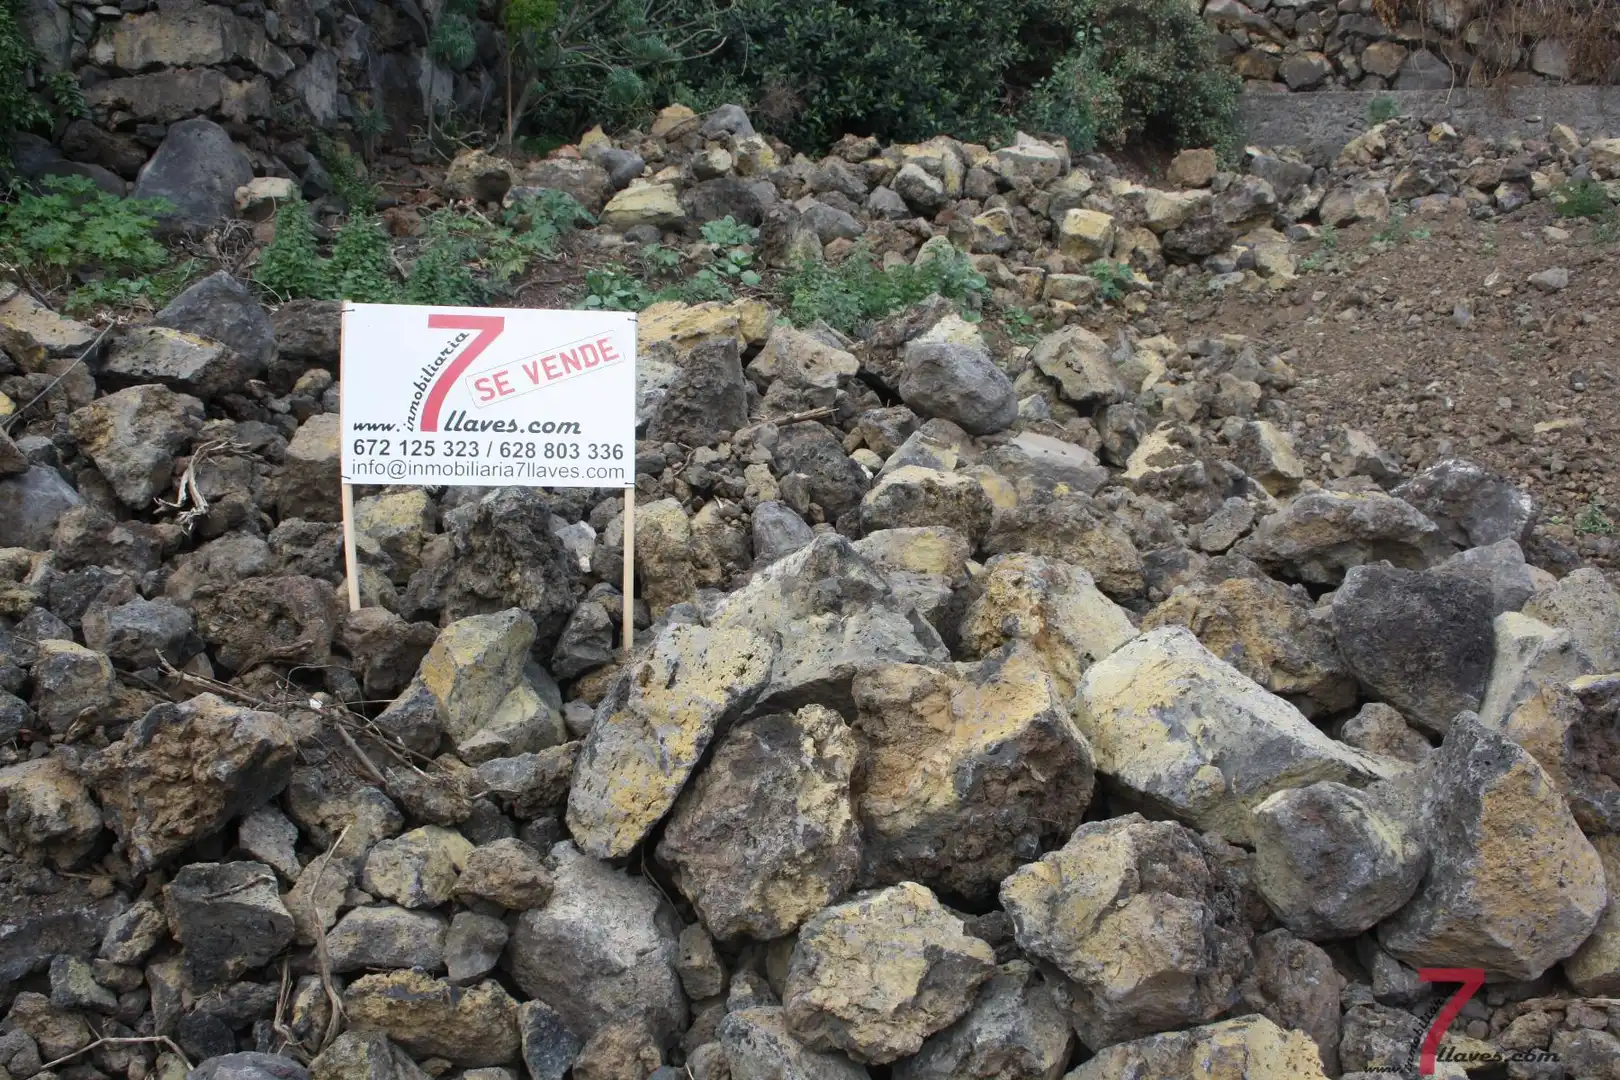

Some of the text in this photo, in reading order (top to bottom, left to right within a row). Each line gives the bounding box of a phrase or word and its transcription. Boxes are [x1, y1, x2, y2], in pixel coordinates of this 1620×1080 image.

[403, 332, 469, 432] inmobiliaria
[420, 314, 505, 432] 7
[474, 337, 620, 401] SE VENDE
[444, 410, 582, 434] llaves.com
[352, 459, 625, 480] info@inmobiliaria7llaves.com
[353, 439, 391, 456] 672
[399, 440, 435, 457] 125
[443, 441, 480, 458] 323
[500, 442, 536, 458] 628
[544, 443, 580, 459] 803
[588, 443, 624, 460] 336
